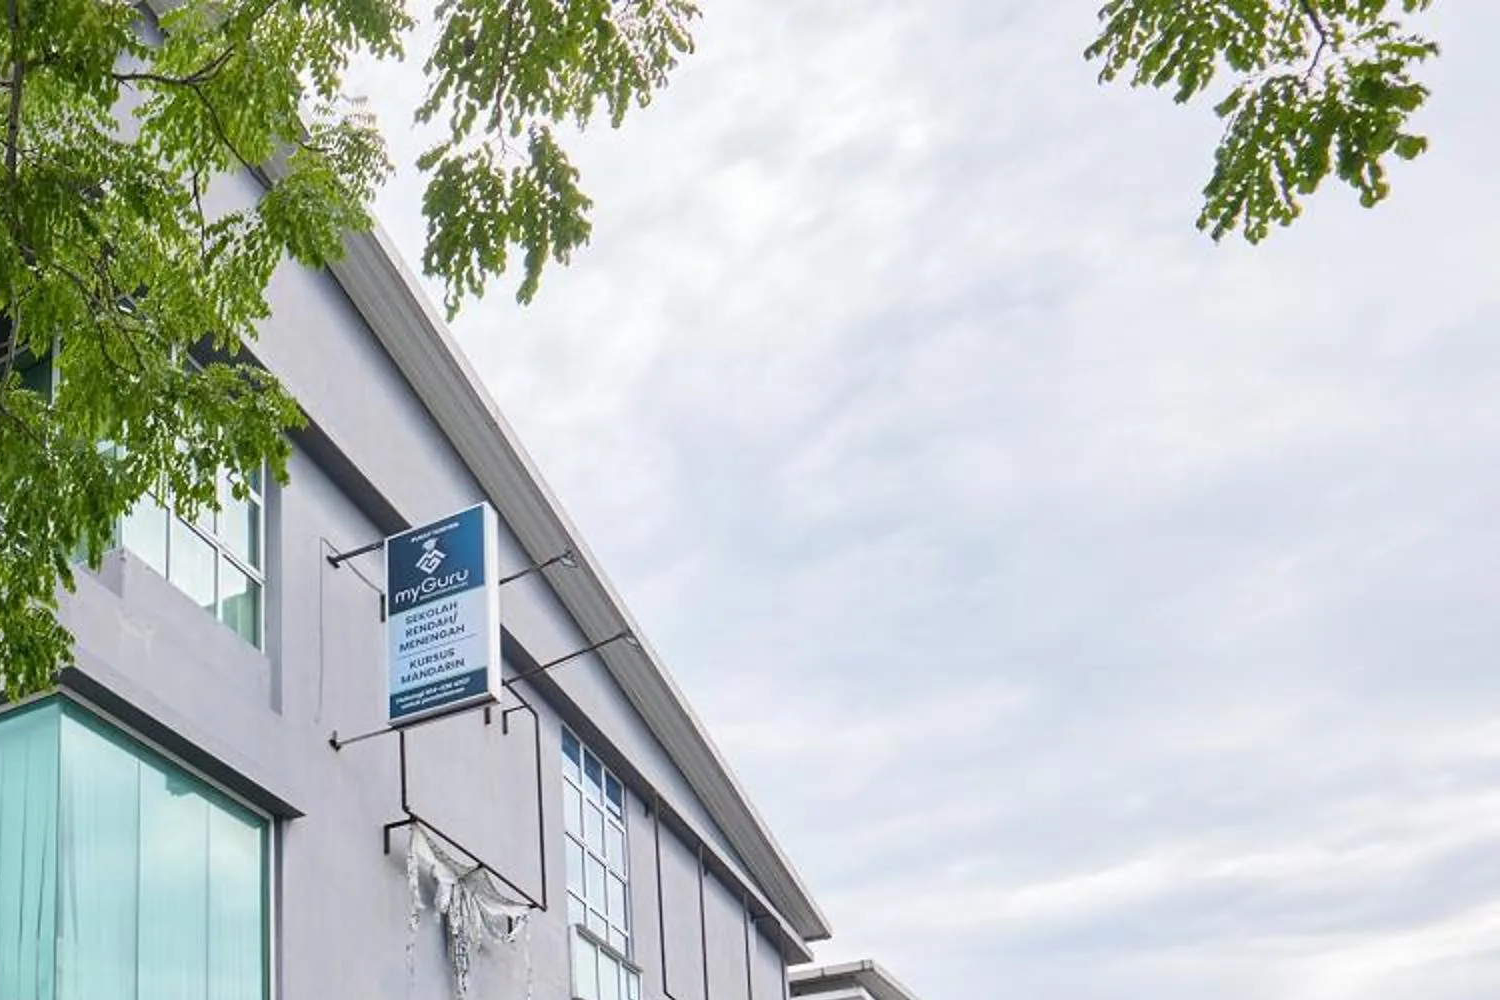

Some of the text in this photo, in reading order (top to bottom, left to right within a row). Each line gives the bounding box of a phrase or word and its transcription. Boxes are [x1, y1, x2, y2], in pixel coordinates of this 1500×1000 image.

[395, 568, 469, 604] myGuru
[405, 601, 458, 625] SEKOLAH
[400, 624, 466, 652] MENENGAH
[401, 658, 466, 685] MANDARIN
[409, 648, 455, 670] KURSUS
